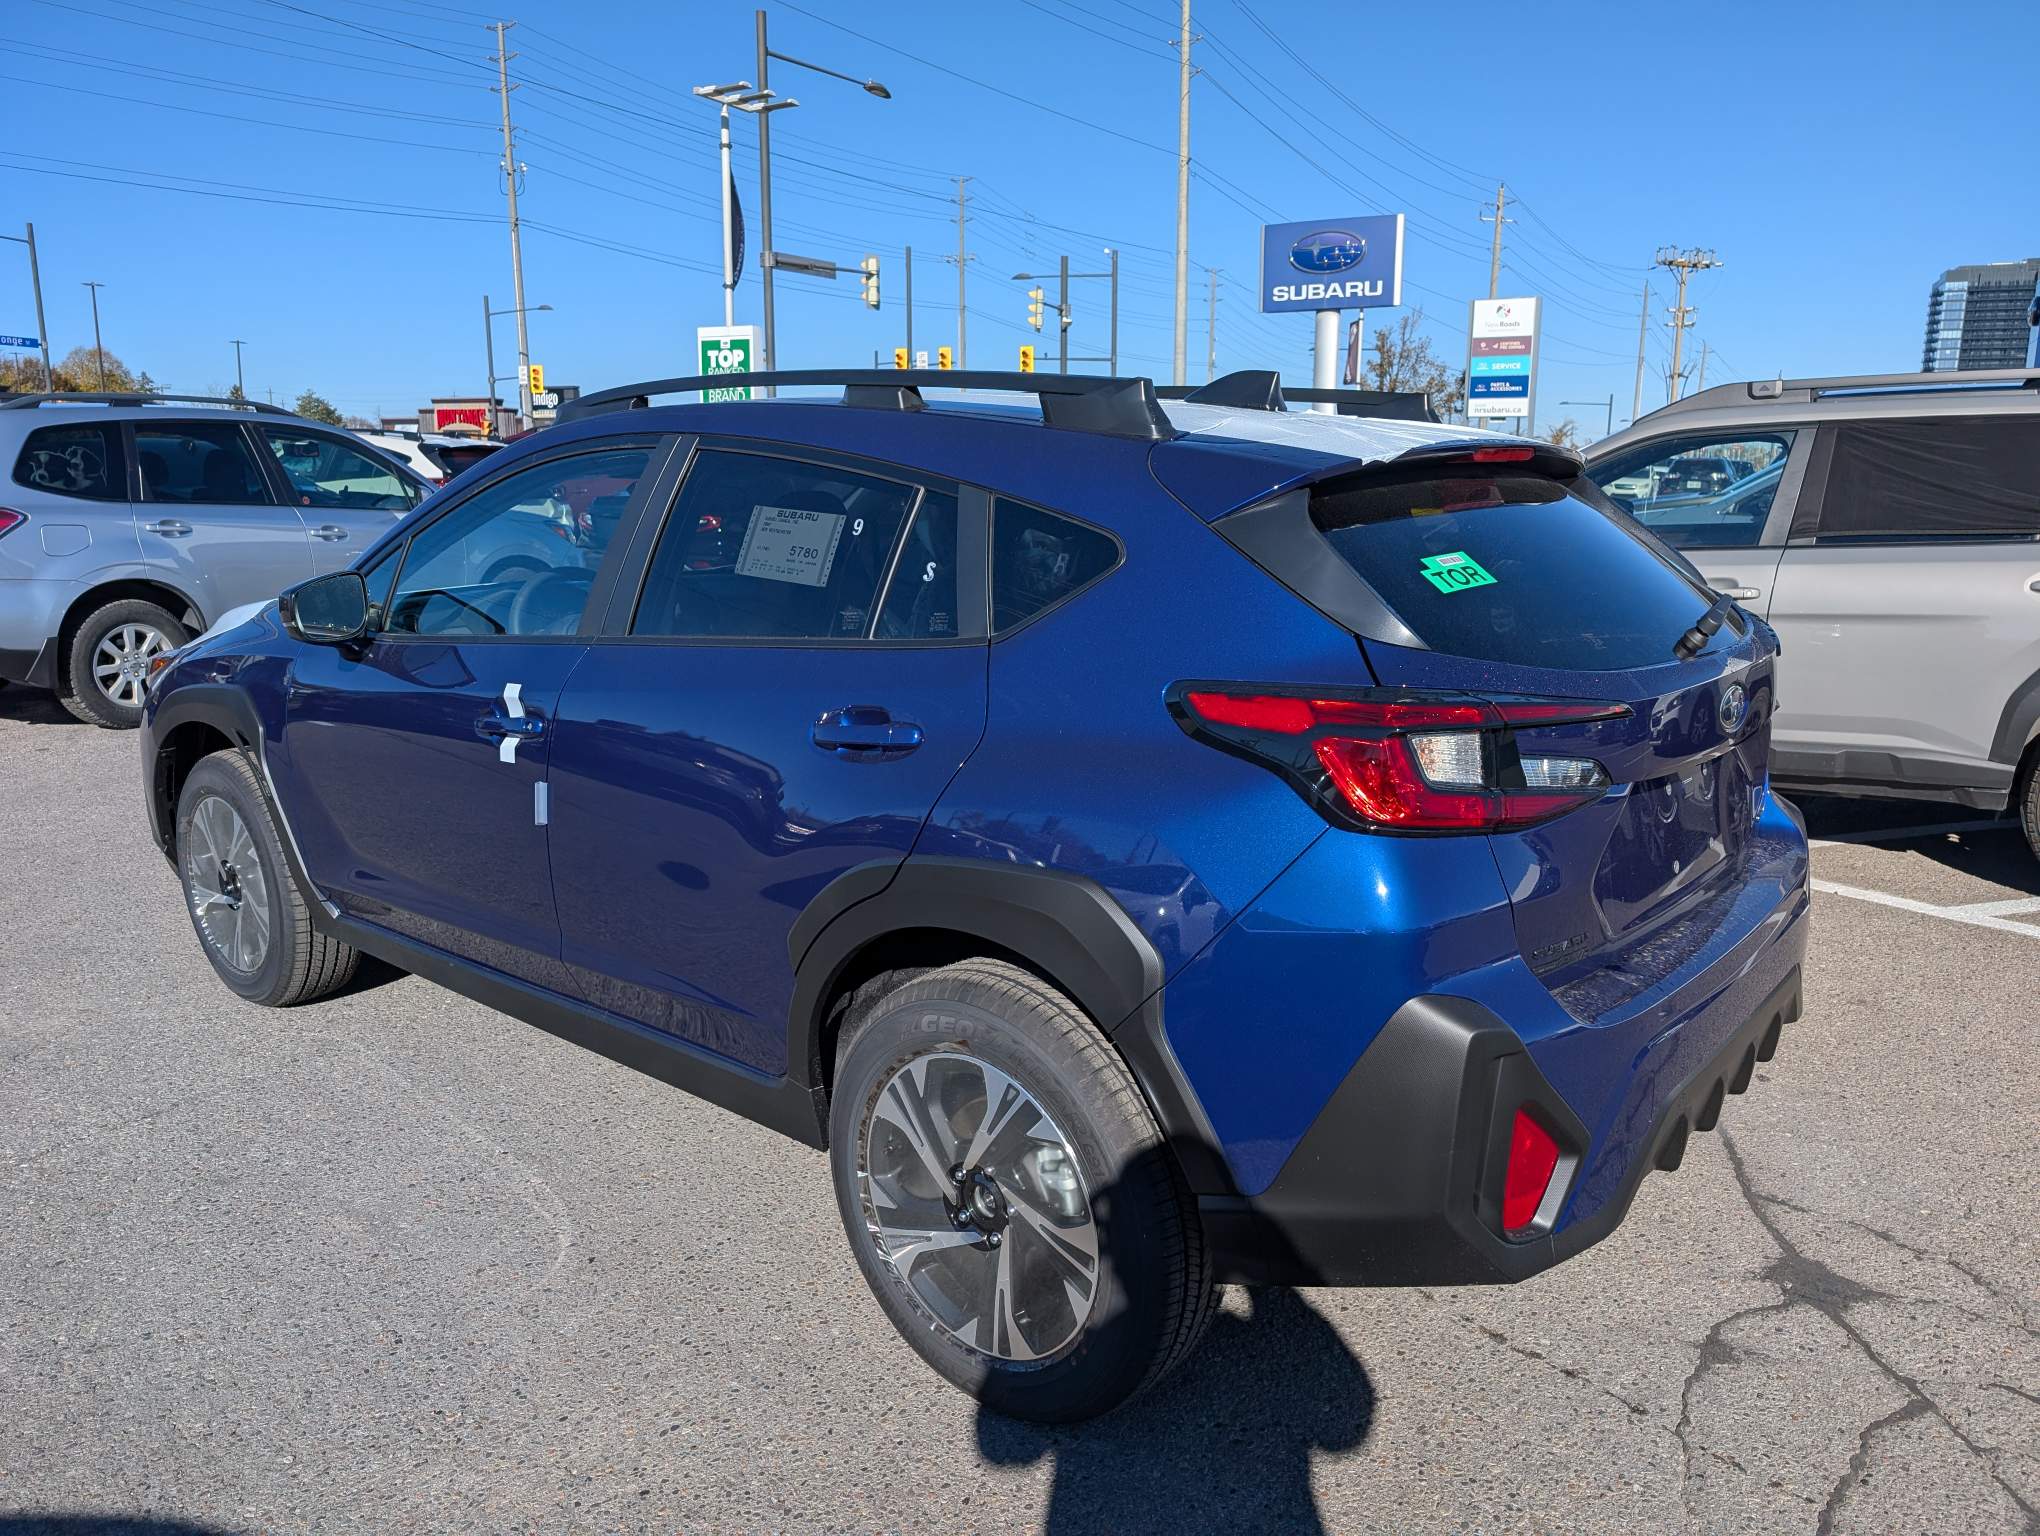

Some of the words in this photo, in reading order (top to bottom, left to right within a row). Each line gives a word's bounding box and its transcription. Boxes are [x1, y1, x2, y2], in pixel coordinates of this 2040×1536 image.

[1272, 280, 1384, 302] SUBARU
[707, 349, 745, 368] TOP
[532, 390, 559, 409] Indigo
[708, 390, 746, 403] BRAND
[776, 509, 820, 522] SUBARU
[852, 518, 864, 536] 9
[789, 545, 818, 560] 5780
[922, 561, 937, 582] S
[1431, 566, 1488, 588] TOR
